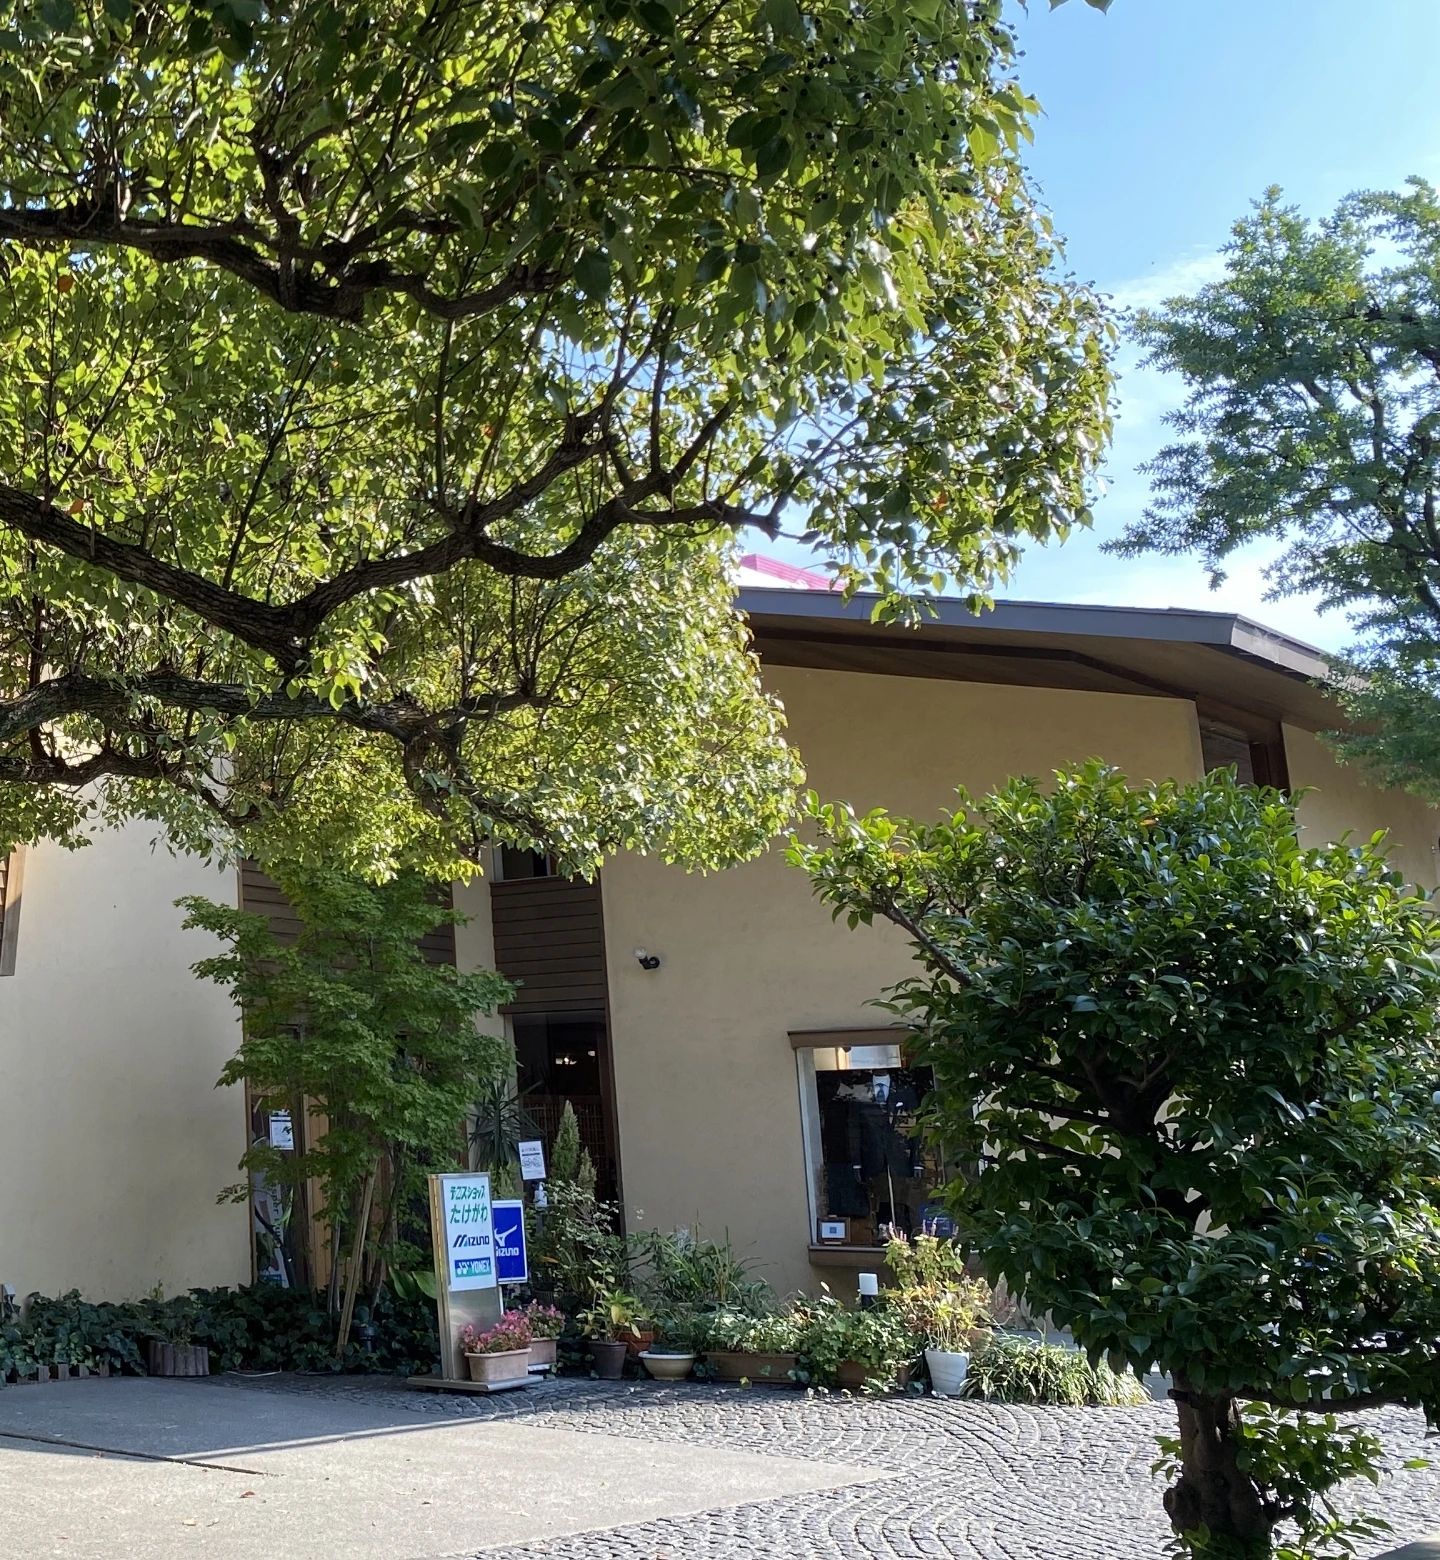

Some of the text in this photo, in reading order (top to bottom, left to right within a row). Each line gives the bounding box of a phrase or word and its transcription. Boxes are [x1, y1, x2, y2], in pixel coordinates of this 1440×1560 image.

[450, 1185, 486, 1200] テニスショップ
[450, 1202, 488, 1224] たけがわ
[471, 1260, 490, 1274] YONEX
